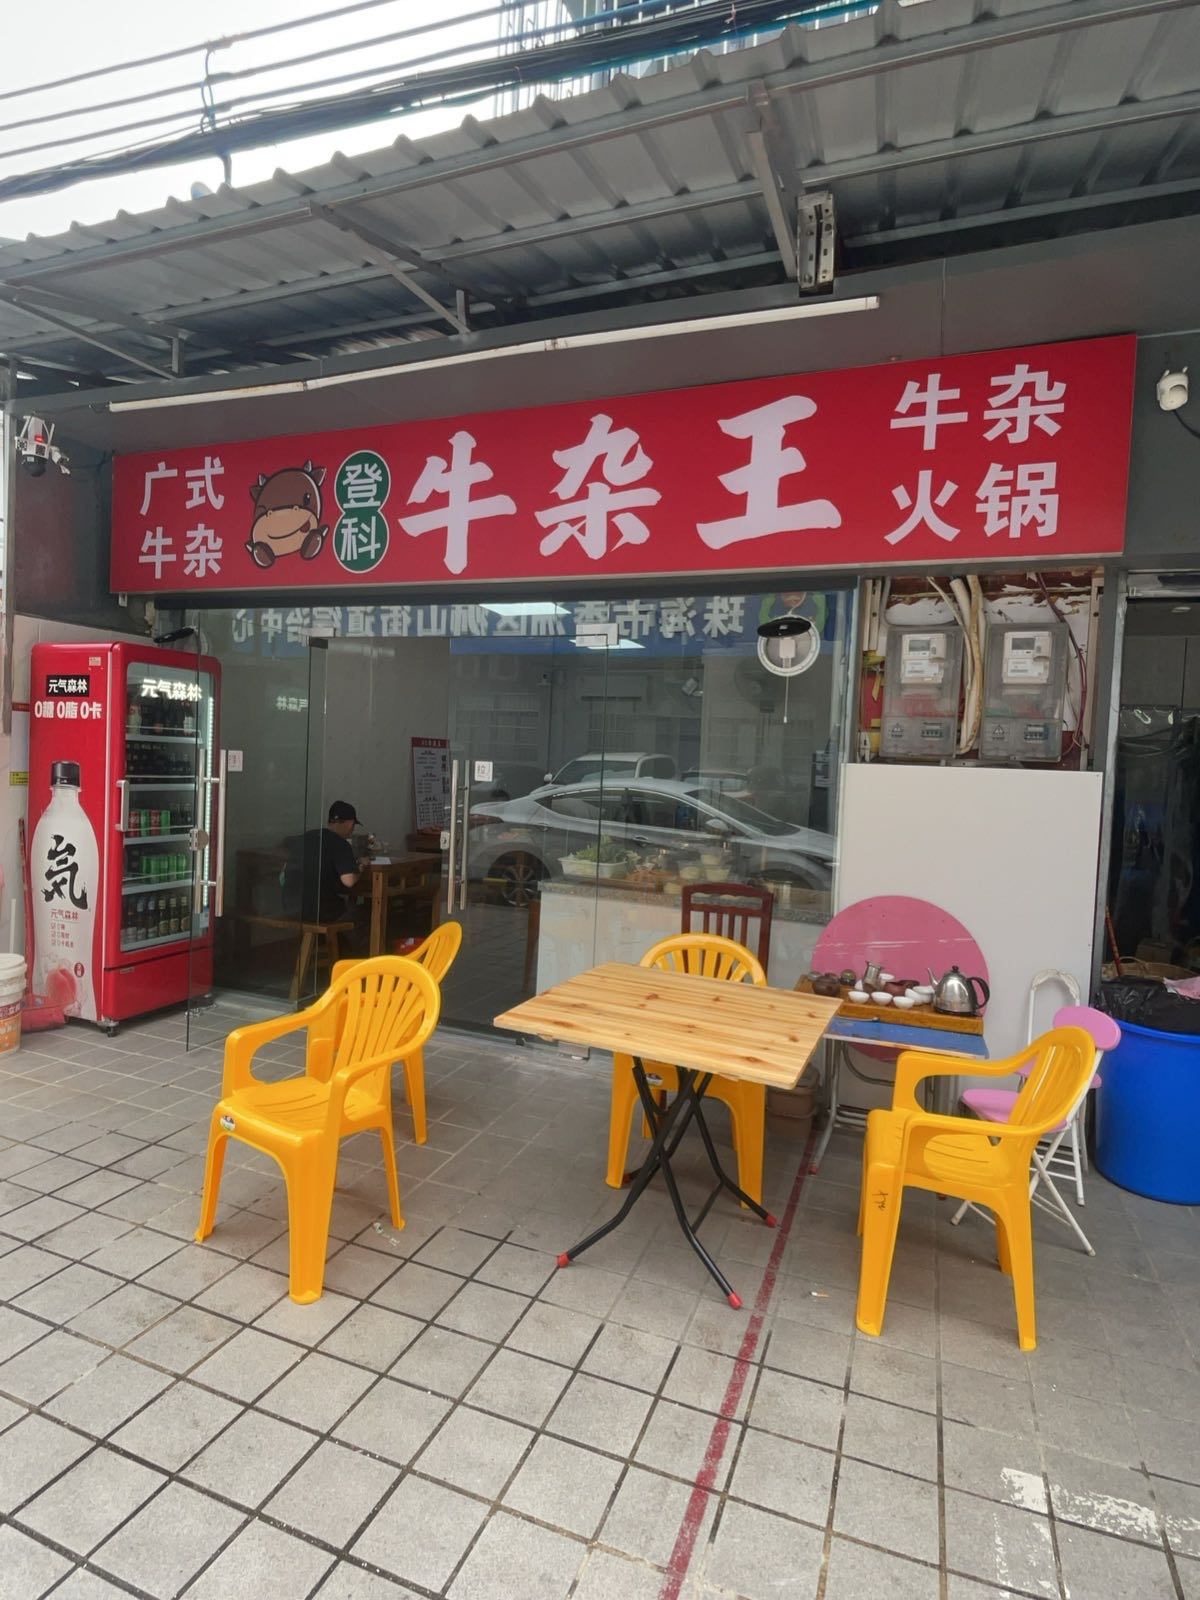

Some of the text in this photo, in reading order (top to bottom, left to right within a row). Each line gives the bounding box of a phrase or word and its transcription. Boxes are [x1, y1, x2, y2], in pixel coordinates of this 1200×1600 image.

[889, 363, 1066, 451] 牛杂
[139, 455, 225, 516] 广式
[340, 463, 383, 561] 登科
[398, 395, 841, 574] 牛杂王
[883, 461, 1059, 546] 火锅
[138, 523, 223, 579] 牛杂
[34, 700, 102, 719] 0糖 0脂 0卡
[48, 678, 88, 693] 元气森林
[140, 678, 203, 702] 元气森林
